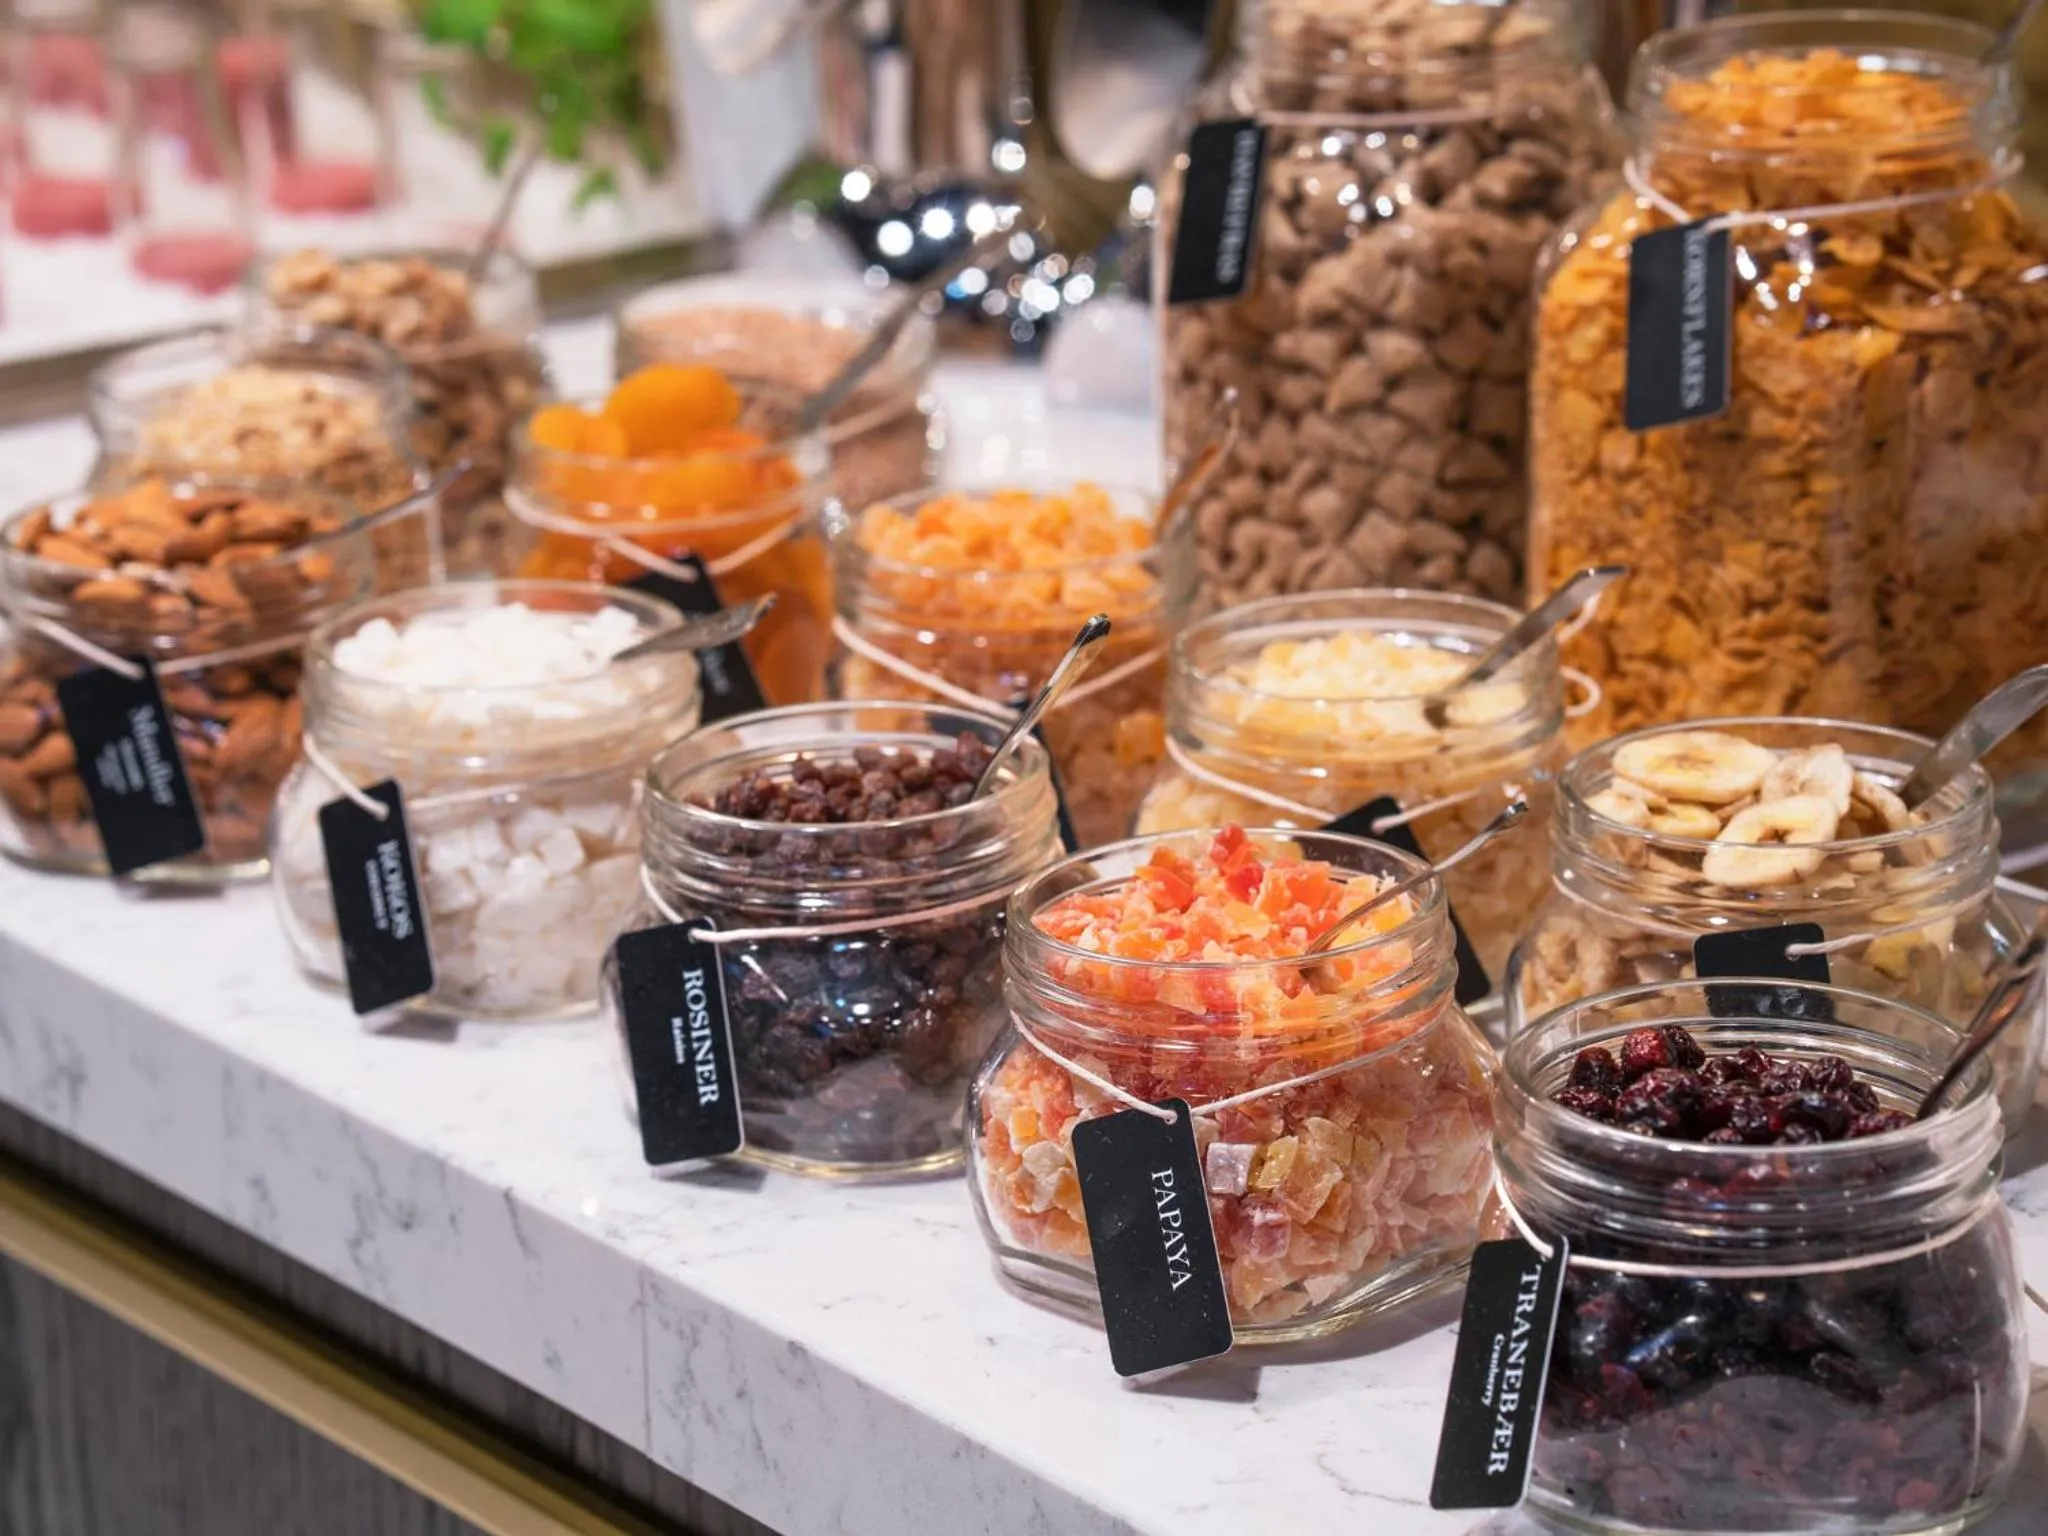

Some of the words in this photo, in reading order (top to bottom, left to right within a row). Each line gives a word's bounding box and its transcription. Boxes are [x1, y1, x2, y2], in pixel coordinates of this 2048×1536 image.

[127, 704, 175, 806] Mandler
[377, 838, 414, 940] KOKOS
[683, 968, 720, 1106] ROSINER
[1151, 1166, 1193, 1292] PAPAYA
[1481, 1333, 1505, 1407] Cranberry
[1486, 1263, 1541, 1475] TRANEBÆR
